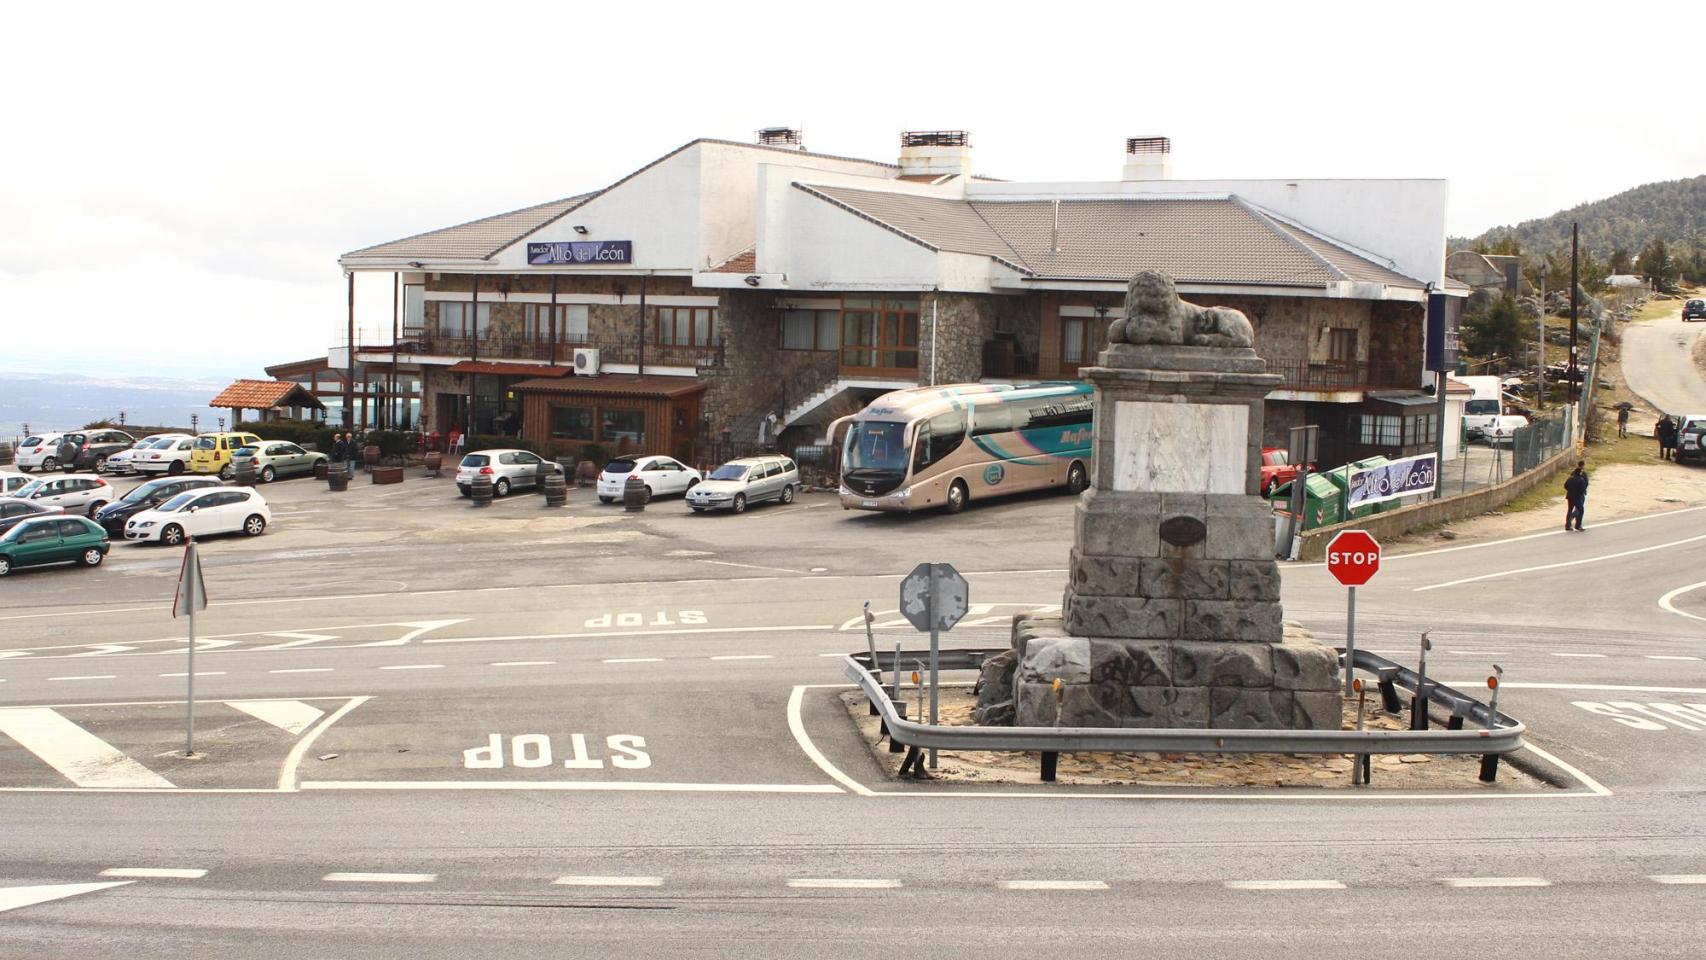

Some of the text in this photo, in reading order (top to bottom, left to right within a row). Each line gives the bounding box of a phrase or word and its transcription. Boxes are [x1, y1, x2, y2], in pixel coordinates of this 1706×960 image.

[549, 245, 572, 261] Alto
[577, 248, 591, 261] del
[595, 245, 624, 261] León
[1363, 475, 1390, 496] Alto
[1405, 464, 1433, 487] León
[1330, 552, 1378, 565] STOP
[584, 610, 708, 628] STOP
[463, 733, 652, 769] STOP
